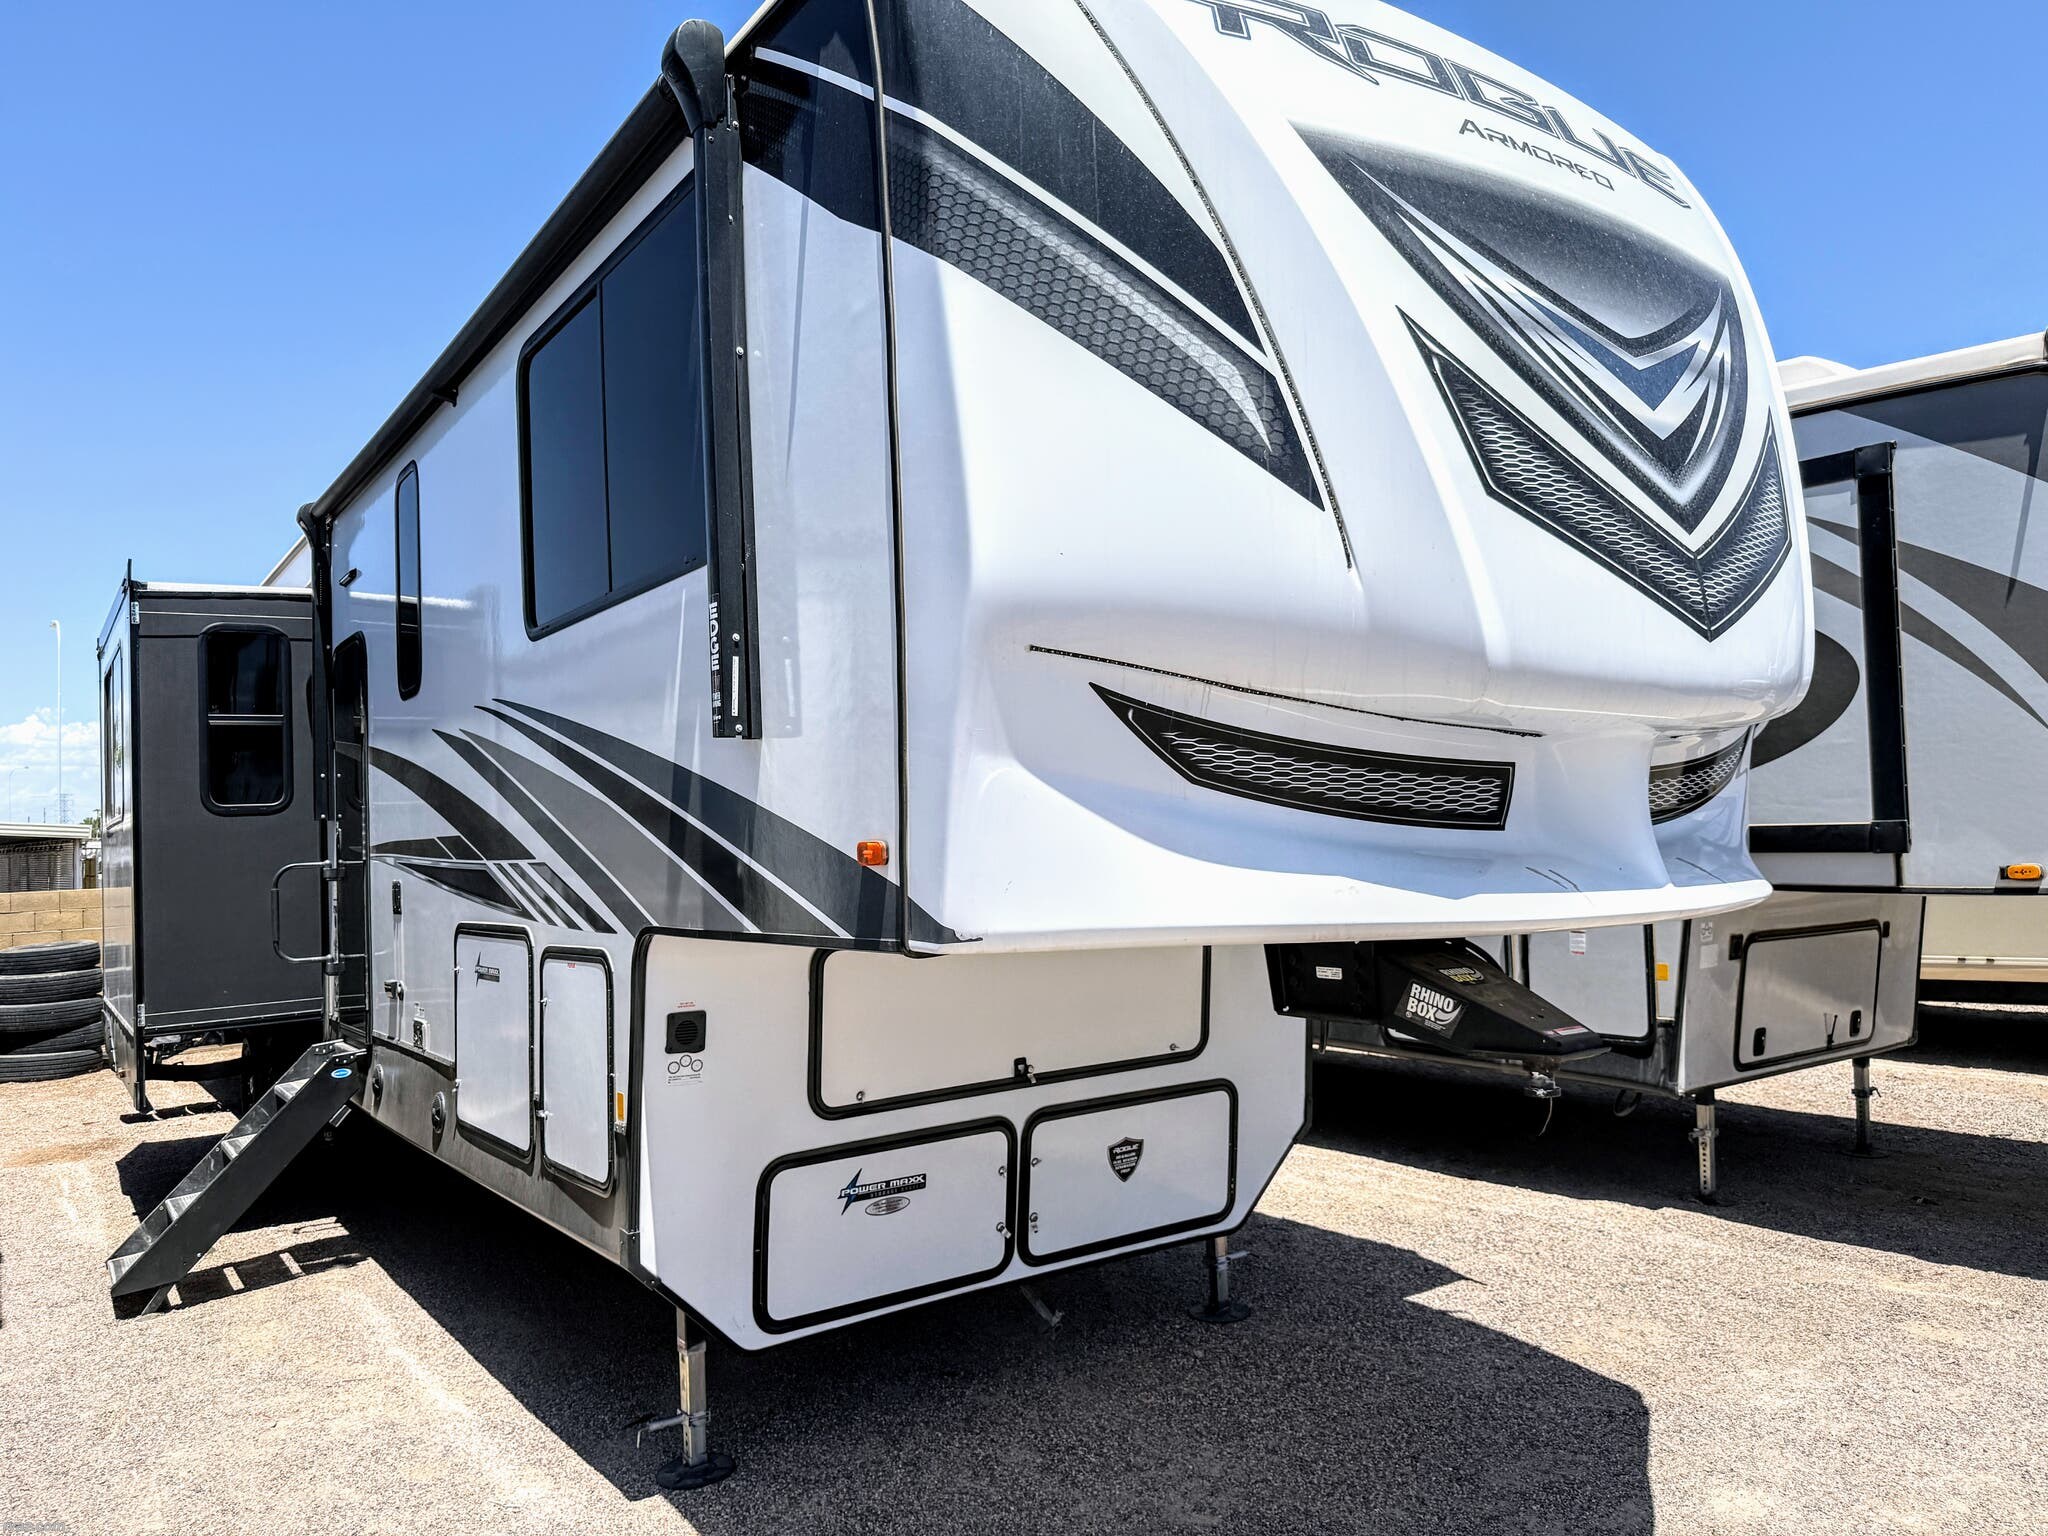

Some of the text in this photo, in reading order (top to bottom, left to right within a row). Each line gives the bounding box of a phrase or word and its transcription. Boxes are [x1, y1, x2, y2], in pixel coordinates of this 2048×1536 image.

[1189, 0, 1691, 209] ROGUE
[1458, 119, 1615, 191] ARMORED
[1406, 997, 1438, 1021] BOX
[1410, 983, 1455, 1012] RHINO
[1113, 1144, 1139, 1153] ROGUE
[841, 1175, 925, 1197] POWER MAXX
